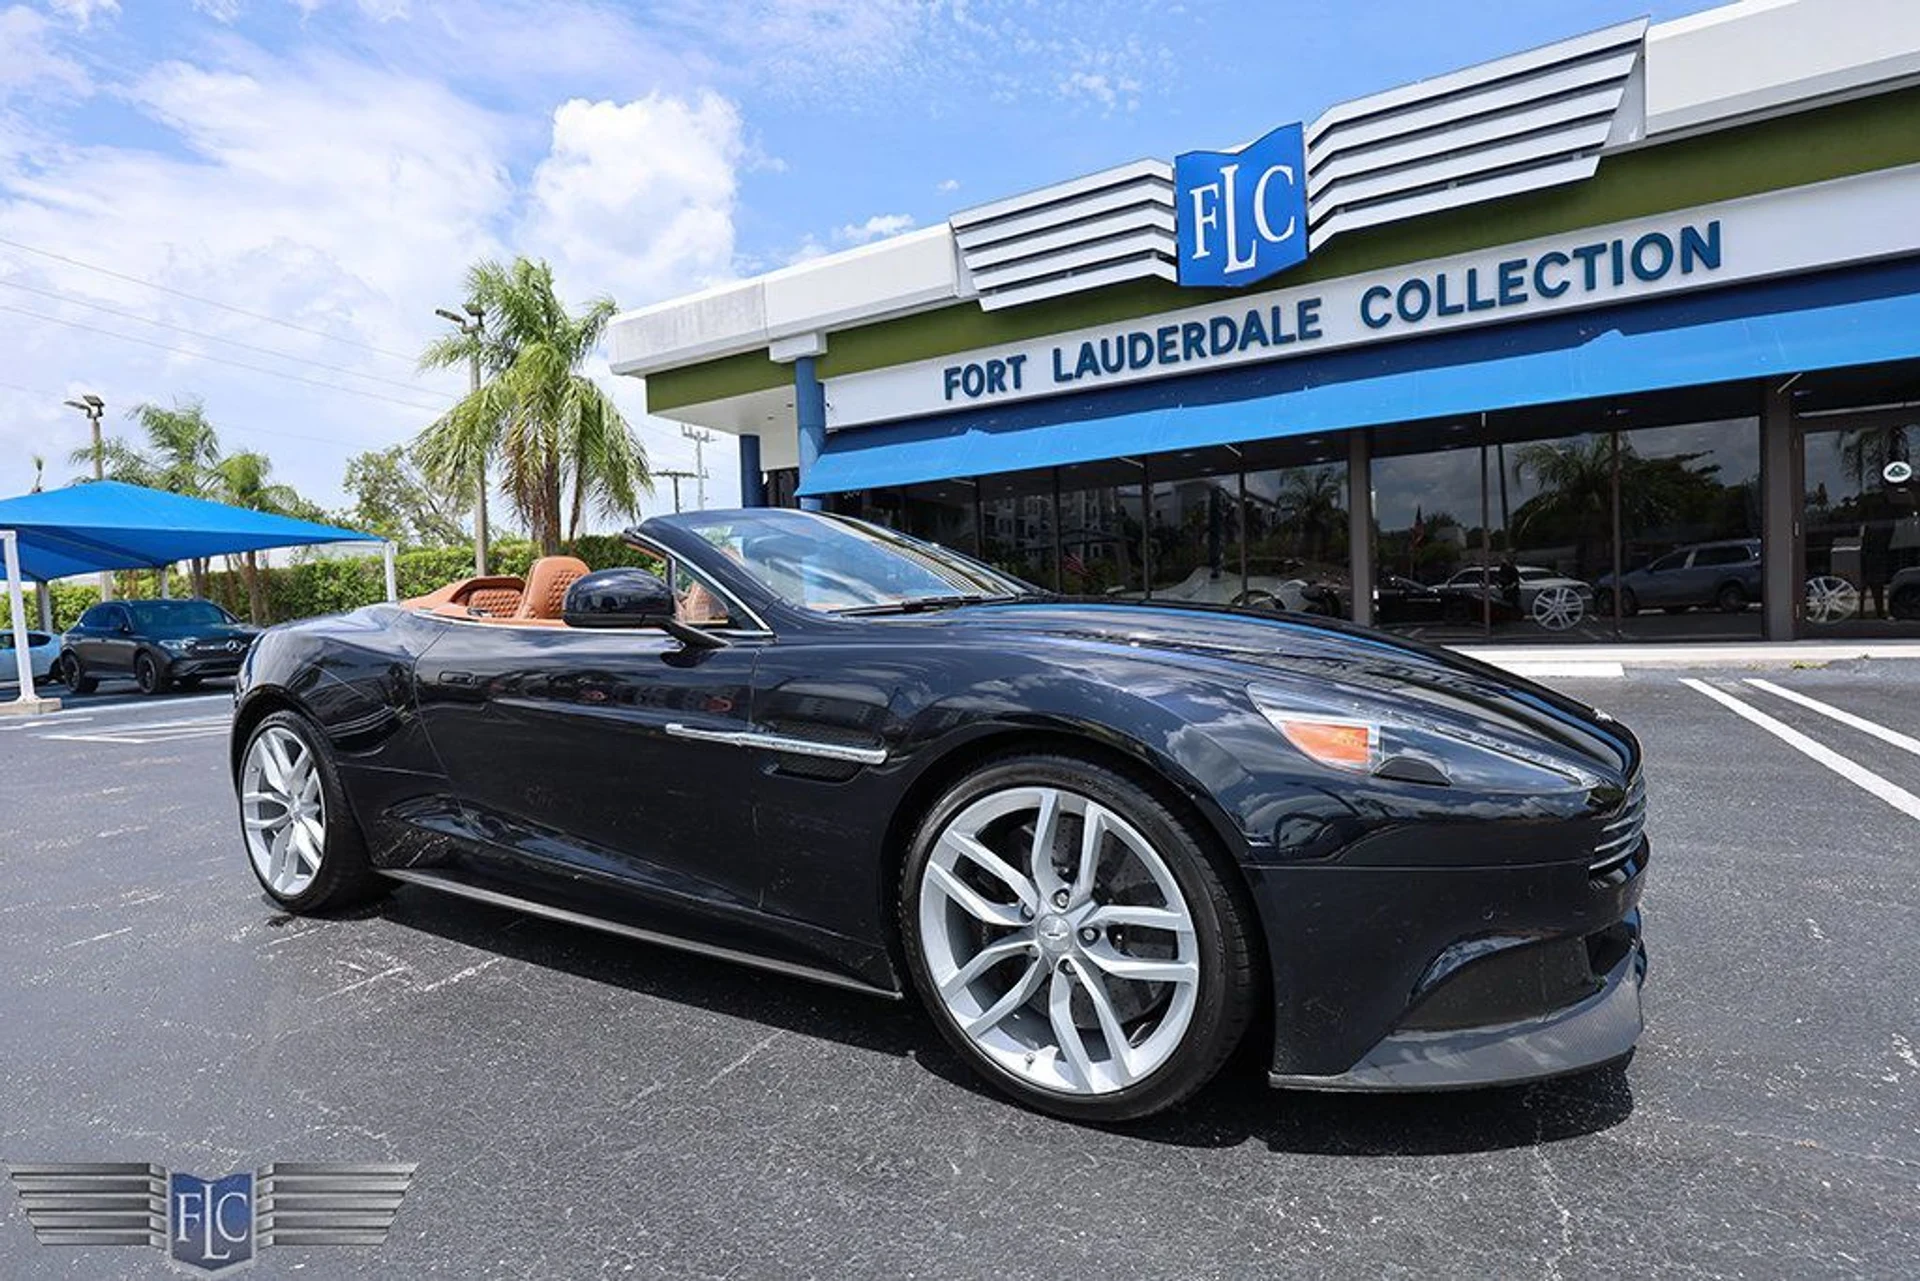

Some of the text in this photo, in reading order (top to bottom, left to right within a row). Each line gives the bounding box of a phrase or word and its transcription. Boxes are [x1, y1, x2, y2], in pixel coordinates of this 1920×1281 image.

[1189, 164, 1295, 274] FLC
[944, 220, 1721, 400] FORT LAUDERDALE COLLECTION
